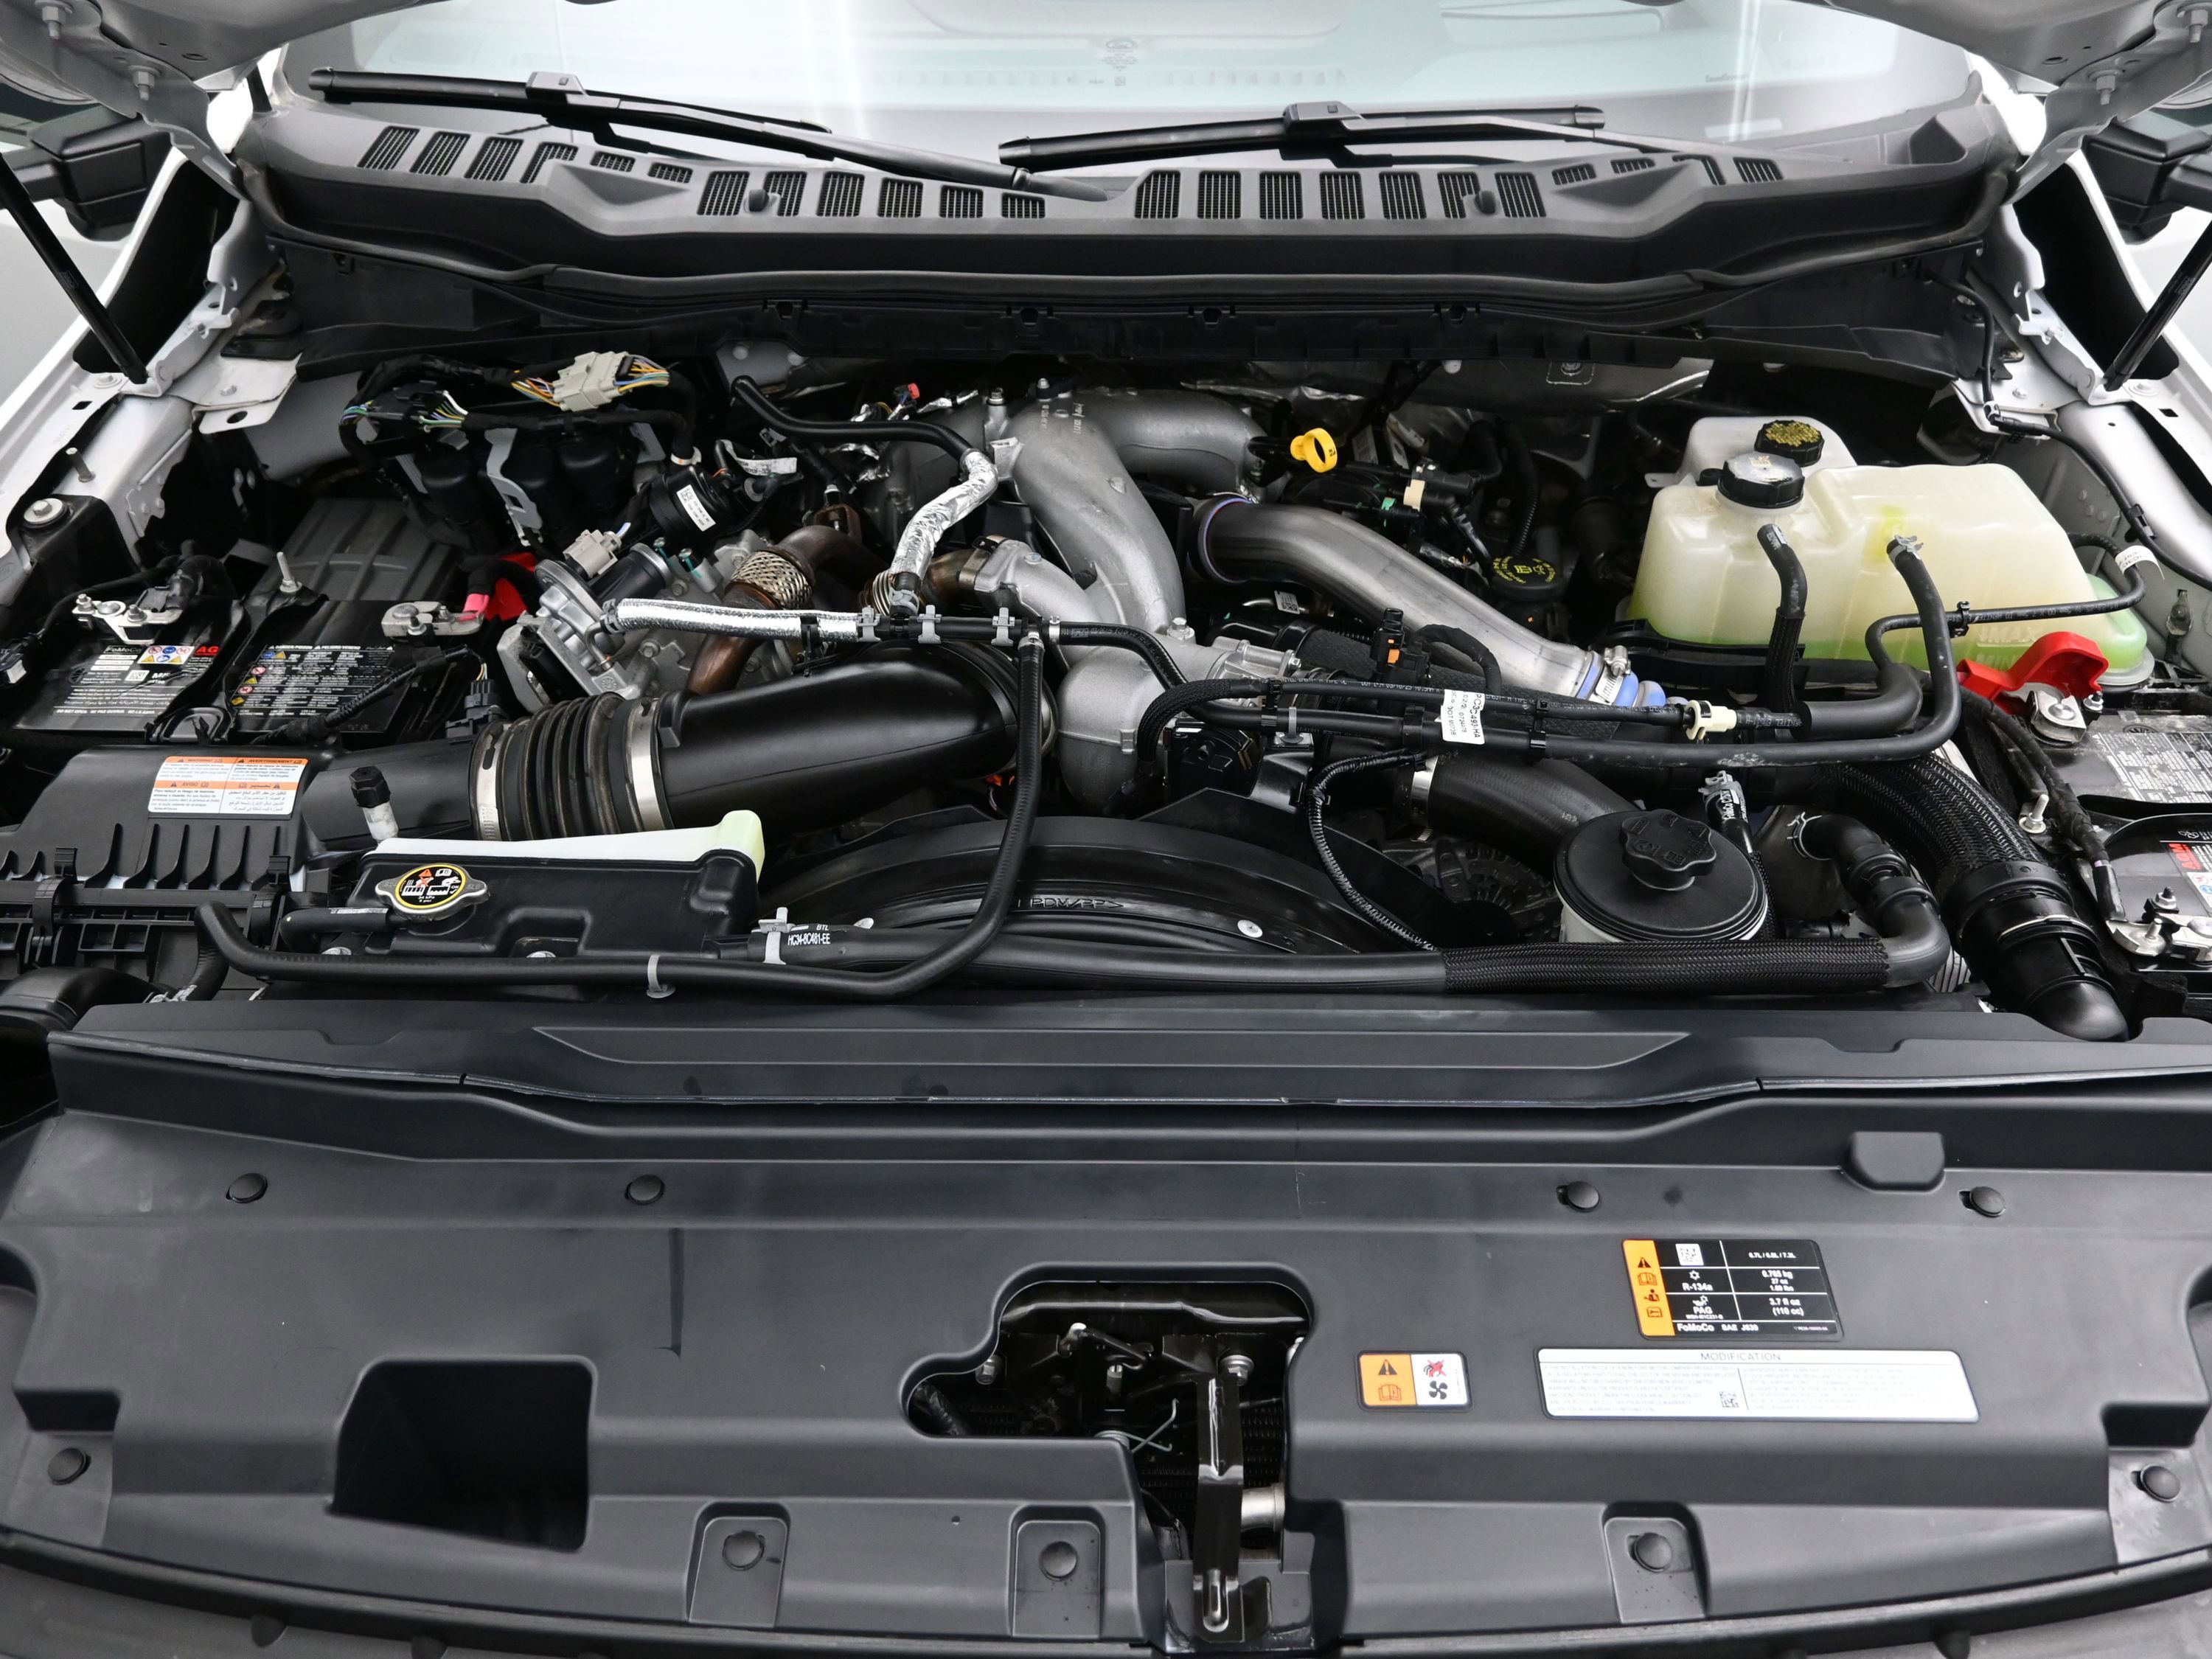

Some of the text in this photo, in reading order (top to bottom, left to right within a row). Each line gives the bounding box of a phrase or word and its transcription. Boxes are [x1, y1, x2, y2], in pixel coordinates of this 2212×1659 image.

[2168, 843, 2196, 870] AGM
[1682, 1282, 1713, 1291] R-134a
[1692, 1306, 1713, 1314] PAG
[1677, 1323, 1715, 1332] FoMoCo
[1721, 1324, 1739, 1332] SAE
[1700, 1352, 1781, 1361] MODIFICATION
